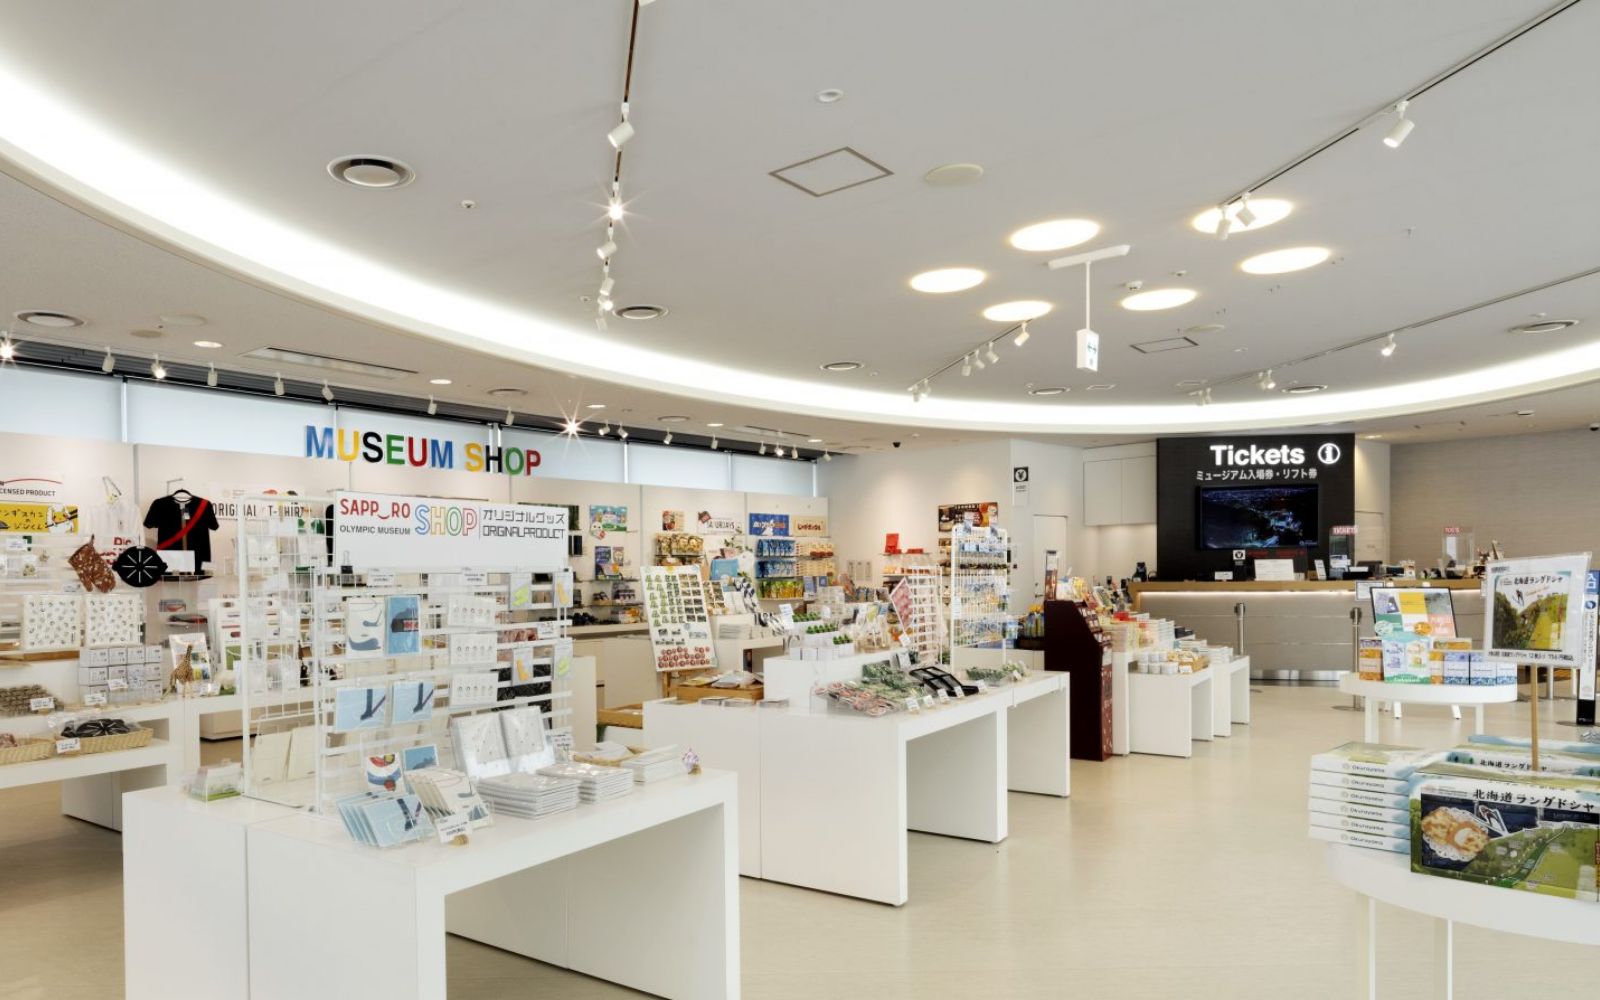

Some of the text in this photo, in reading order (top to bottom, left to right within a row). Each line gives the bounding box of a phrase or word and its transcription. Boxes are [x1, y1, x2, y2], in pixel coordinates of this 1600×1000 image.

[306, 425, 541, 476] MUSEUM SHOP
[1209, 444, 1305, 466] Tickets
[25, 489, 56, 497] PRODUCT
[340, 525, 411, 535] OLYMPIC MUSEUM
[415, 504, 477, 536] SHOP
[1473, 788, 1595, 813] 北海道ラングドシャ
